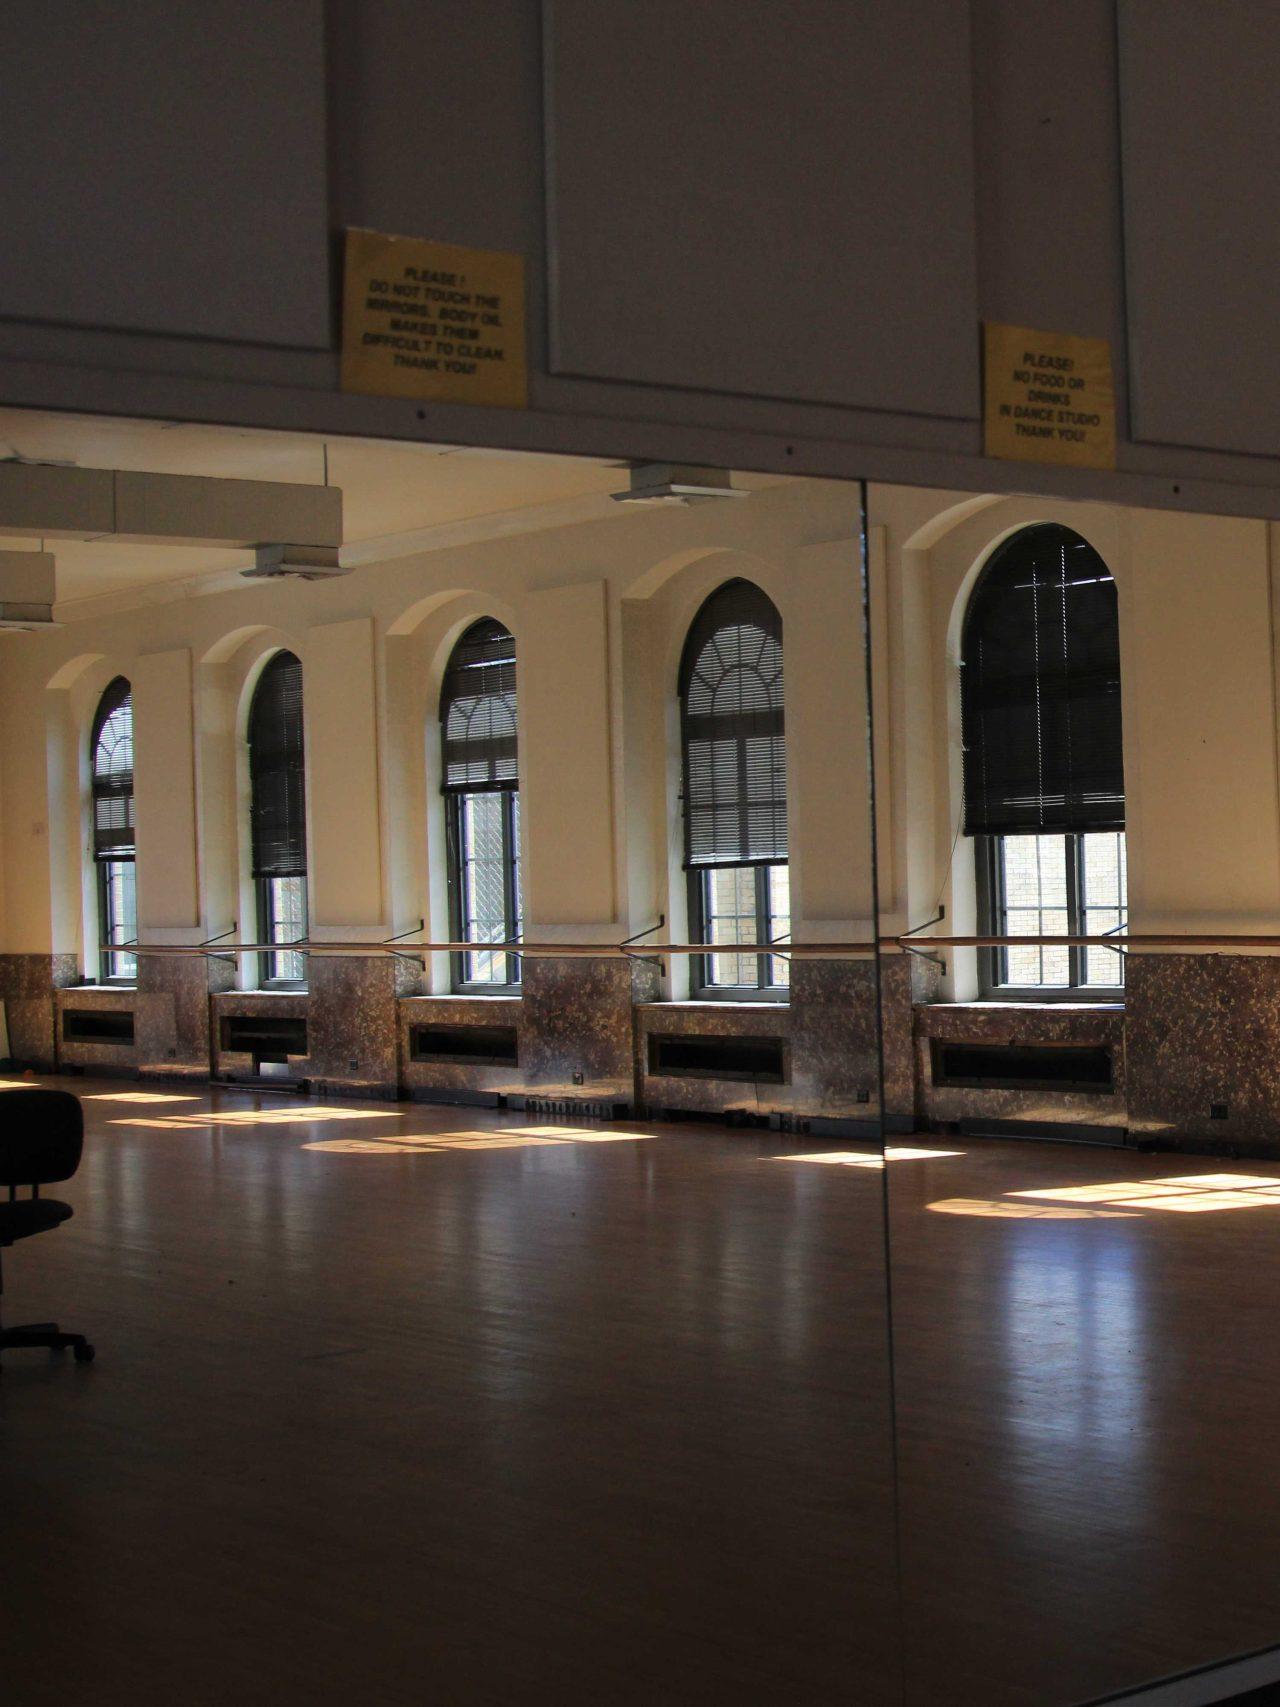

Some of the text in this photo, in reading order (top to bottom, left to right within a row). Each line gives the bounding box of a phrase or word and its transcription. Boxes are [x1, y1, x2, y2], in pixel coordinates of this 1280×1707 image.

[368, 279, 500, 309] DO NOT TOUCH THE
[438, 307, 478, 322] BODY
[390, 319, 480, 340] MAKES THEM
[362, 332, 431, 352] DIFFICULT
[436, 341, 454, 355] TO
[393, 354, 439, 371] THANK
[1013, 370, 1085, 391] NO FOOD OR
[1028, 389, 1071, 406] DRINKS
[999, 403, 1100, 426] IN DANCE STUDIO
[1015, 423, 1055, 438] THANK
